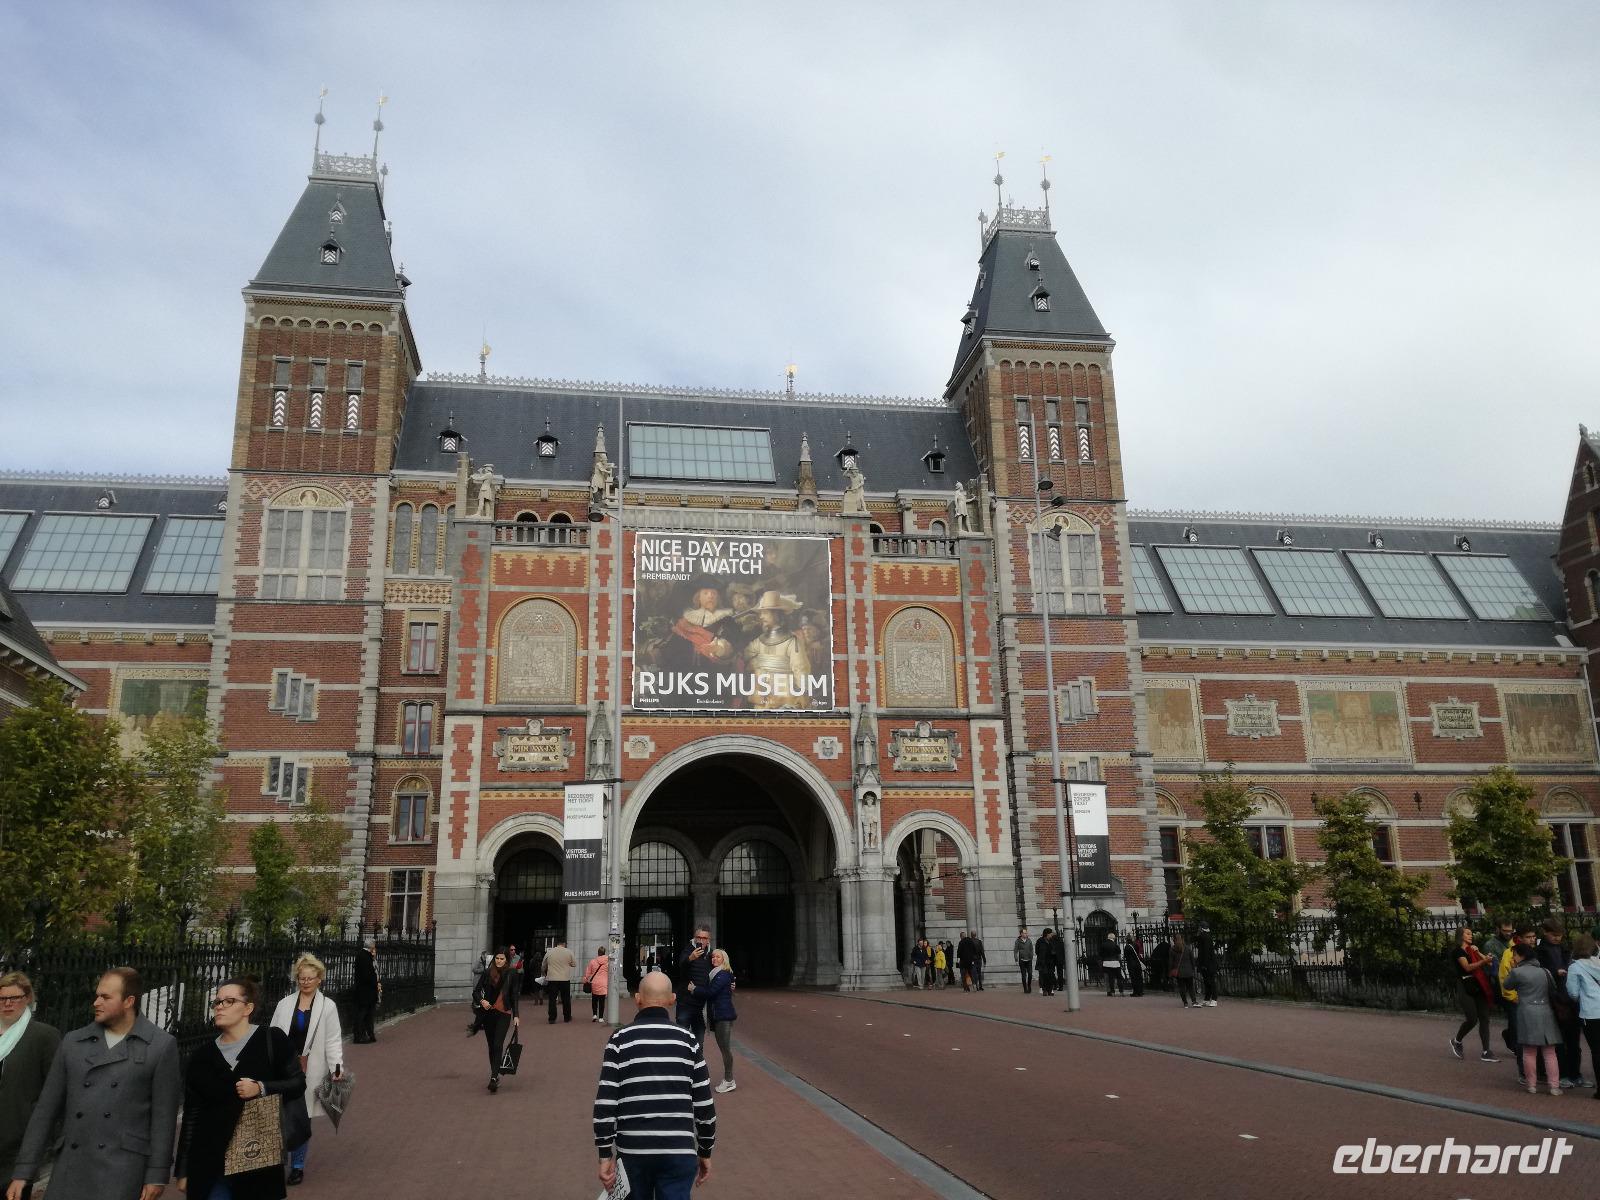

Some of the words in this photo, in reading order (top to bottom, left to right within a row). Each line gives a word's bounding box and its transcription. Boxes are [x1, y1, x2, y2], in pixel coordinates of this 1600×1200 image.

[641, 538, 682, 556] NICE
[688, 540, 724, 557] DAY
[729, 542, 764, 558] FOR
[641, 555, 696, 573] NIGHT
[700, 558, 762, 575] WATCH
[641, 573, 690, 581] #REMBRANDT
[639, 671, 709, 695] RIJKS
[717, 672, 828, 697] MUSEUM
